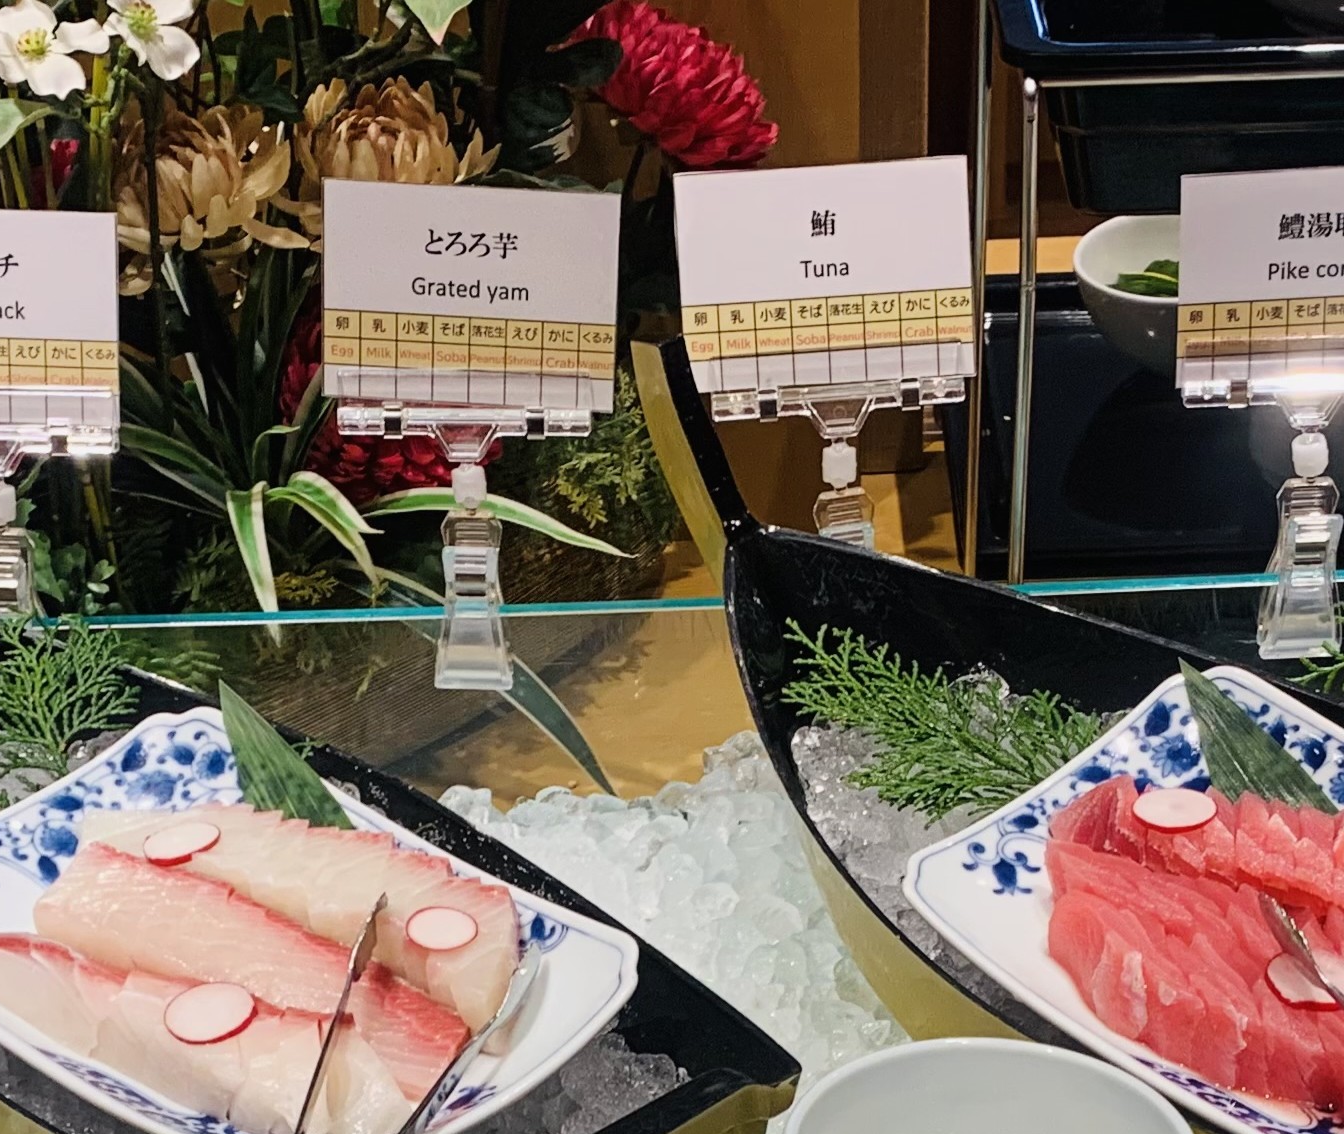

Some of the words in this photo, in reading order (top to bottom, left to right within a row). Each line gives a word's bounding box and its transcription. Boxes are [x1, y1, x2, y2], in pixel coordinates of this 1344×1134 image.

[810, 210, 836, 236] 鮪
[424, 229, 519, 259] とろろ芋
[800, 260, 850, 278] Tuna
[1268, 261, 1309, 280] Pike
[412, 277, 481, 299] Grated
[487, 285, 529, 303] yam
[694, 312, 708, 326] 卵
[731, 311, 744, 324] 乳
[760, 308, 787, 322] 小麦
[798, 305, 823, 318] そば
[829, 303, 863, 317] 落花生
[870, 300, 896, 313] えび
[906, 298, 931, 312] かに
[940, 296, 970, 308] くるみ
[1189, 310, 1203, 323] 卵
[1227, 308, 1240, 322] 乳
[1256, 306, 1284, 320] 小麦
[1294, 304, 1320, 317] そば
[336, 317, 349, 330] 卵
[372, 319, 386, 333] 乳
[402, 320, 430, 335] 小麦
[440, 323, 465, 336] そば
[471, 325, 505, 339] 落花生
[511, 327, 538, 341] えび
[548, 329, 574, 343] かに
[582, 332, 613, 344] くるみ
[691, 341, 714, 354] Egg
[726, 337, 751, 350] Milk
[759, 336, 790, 347] Wheat
[796, 332, 826, 346] Soba
[905, 326, 934, 338] Crab
[16, 346, 40, 359] えび
[52, 347, 77, 360] かに
[85, 349, 115, 361] くるみ
[331, 345, 354, 358] Egg
[366, 347, 392, 359] Milk
[399, 350, 430, 361] Wheat
[436, 351, 467, 363] Soba
[546, 357, 576, 369] Crab
